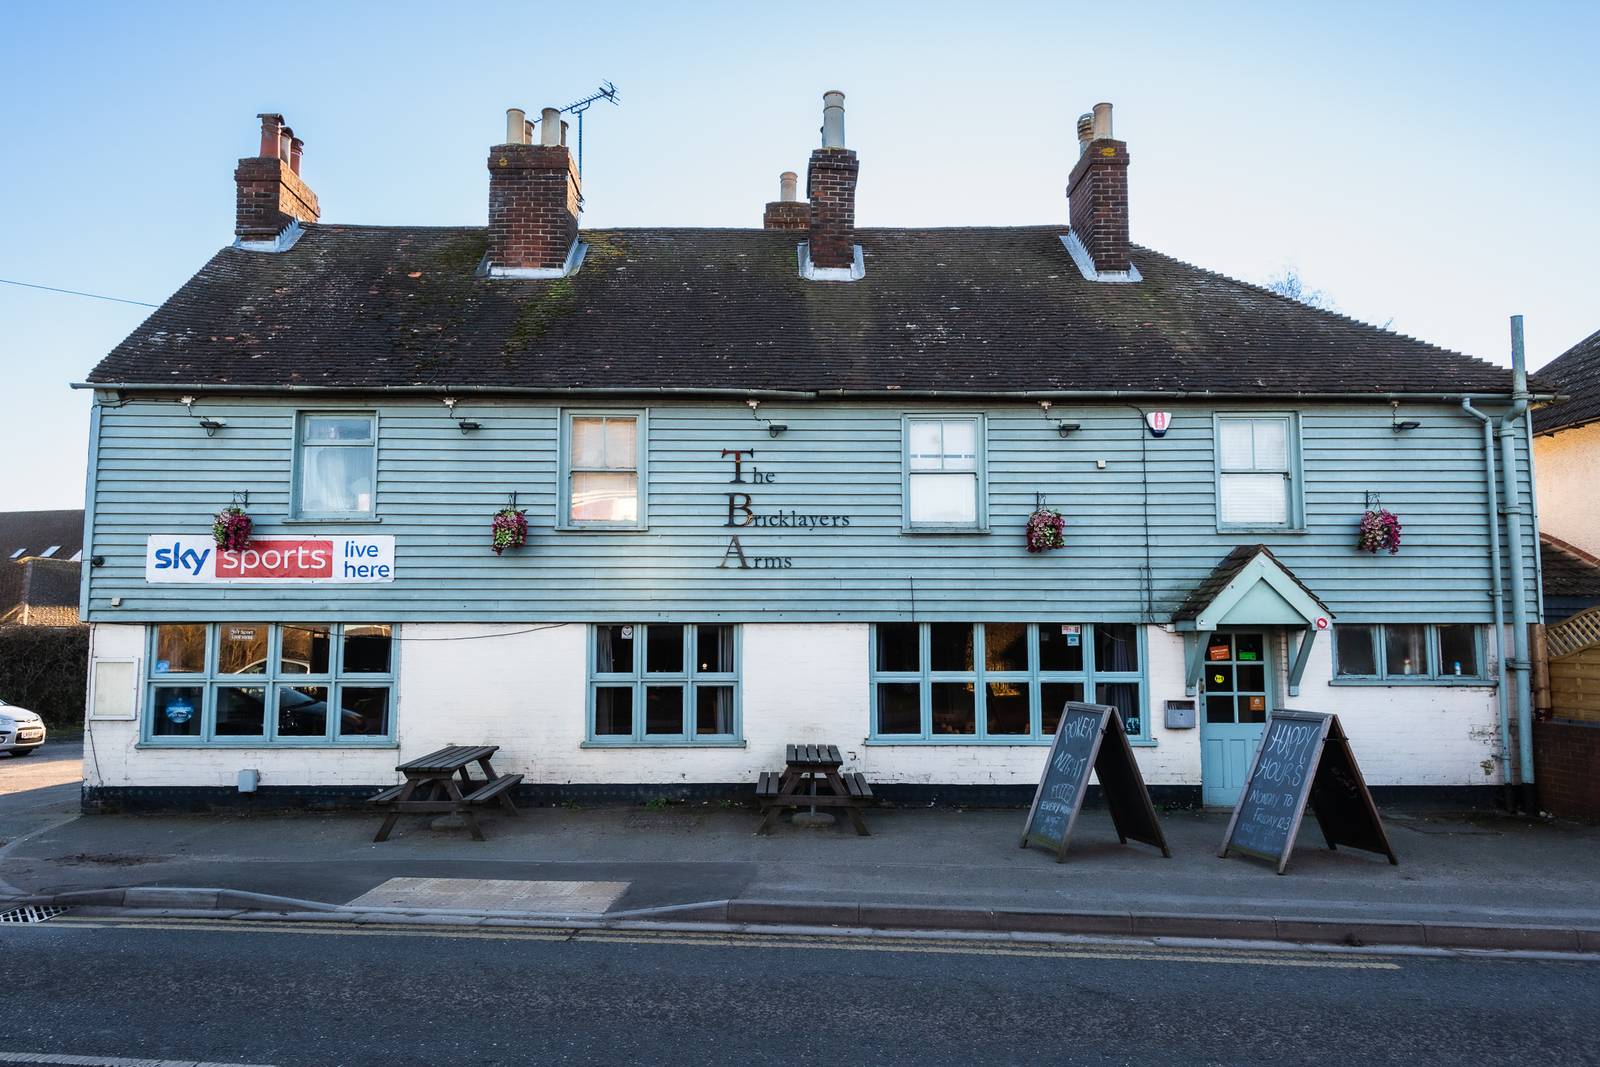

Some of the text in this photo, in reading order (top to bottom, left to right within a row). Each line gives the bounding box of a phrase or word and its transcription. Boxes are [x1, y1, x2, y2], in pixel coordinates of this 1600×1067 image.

[721, 448, 775, 484] The
[723, 492, 850, 531] Bricklayers
[154, 541, 326, 576] sky sports
[344, 540, 379, 557] live
[717, 534, 792, 569] Arms
[344, 561, 390, 578] here
[1064, 716, 1096, 745] POKER
[1267, 724, 1320, 765] HAPPY
[1053, 750, 1087, 778] NIGHT
[1254, 758, 1304, 787] HOURS
